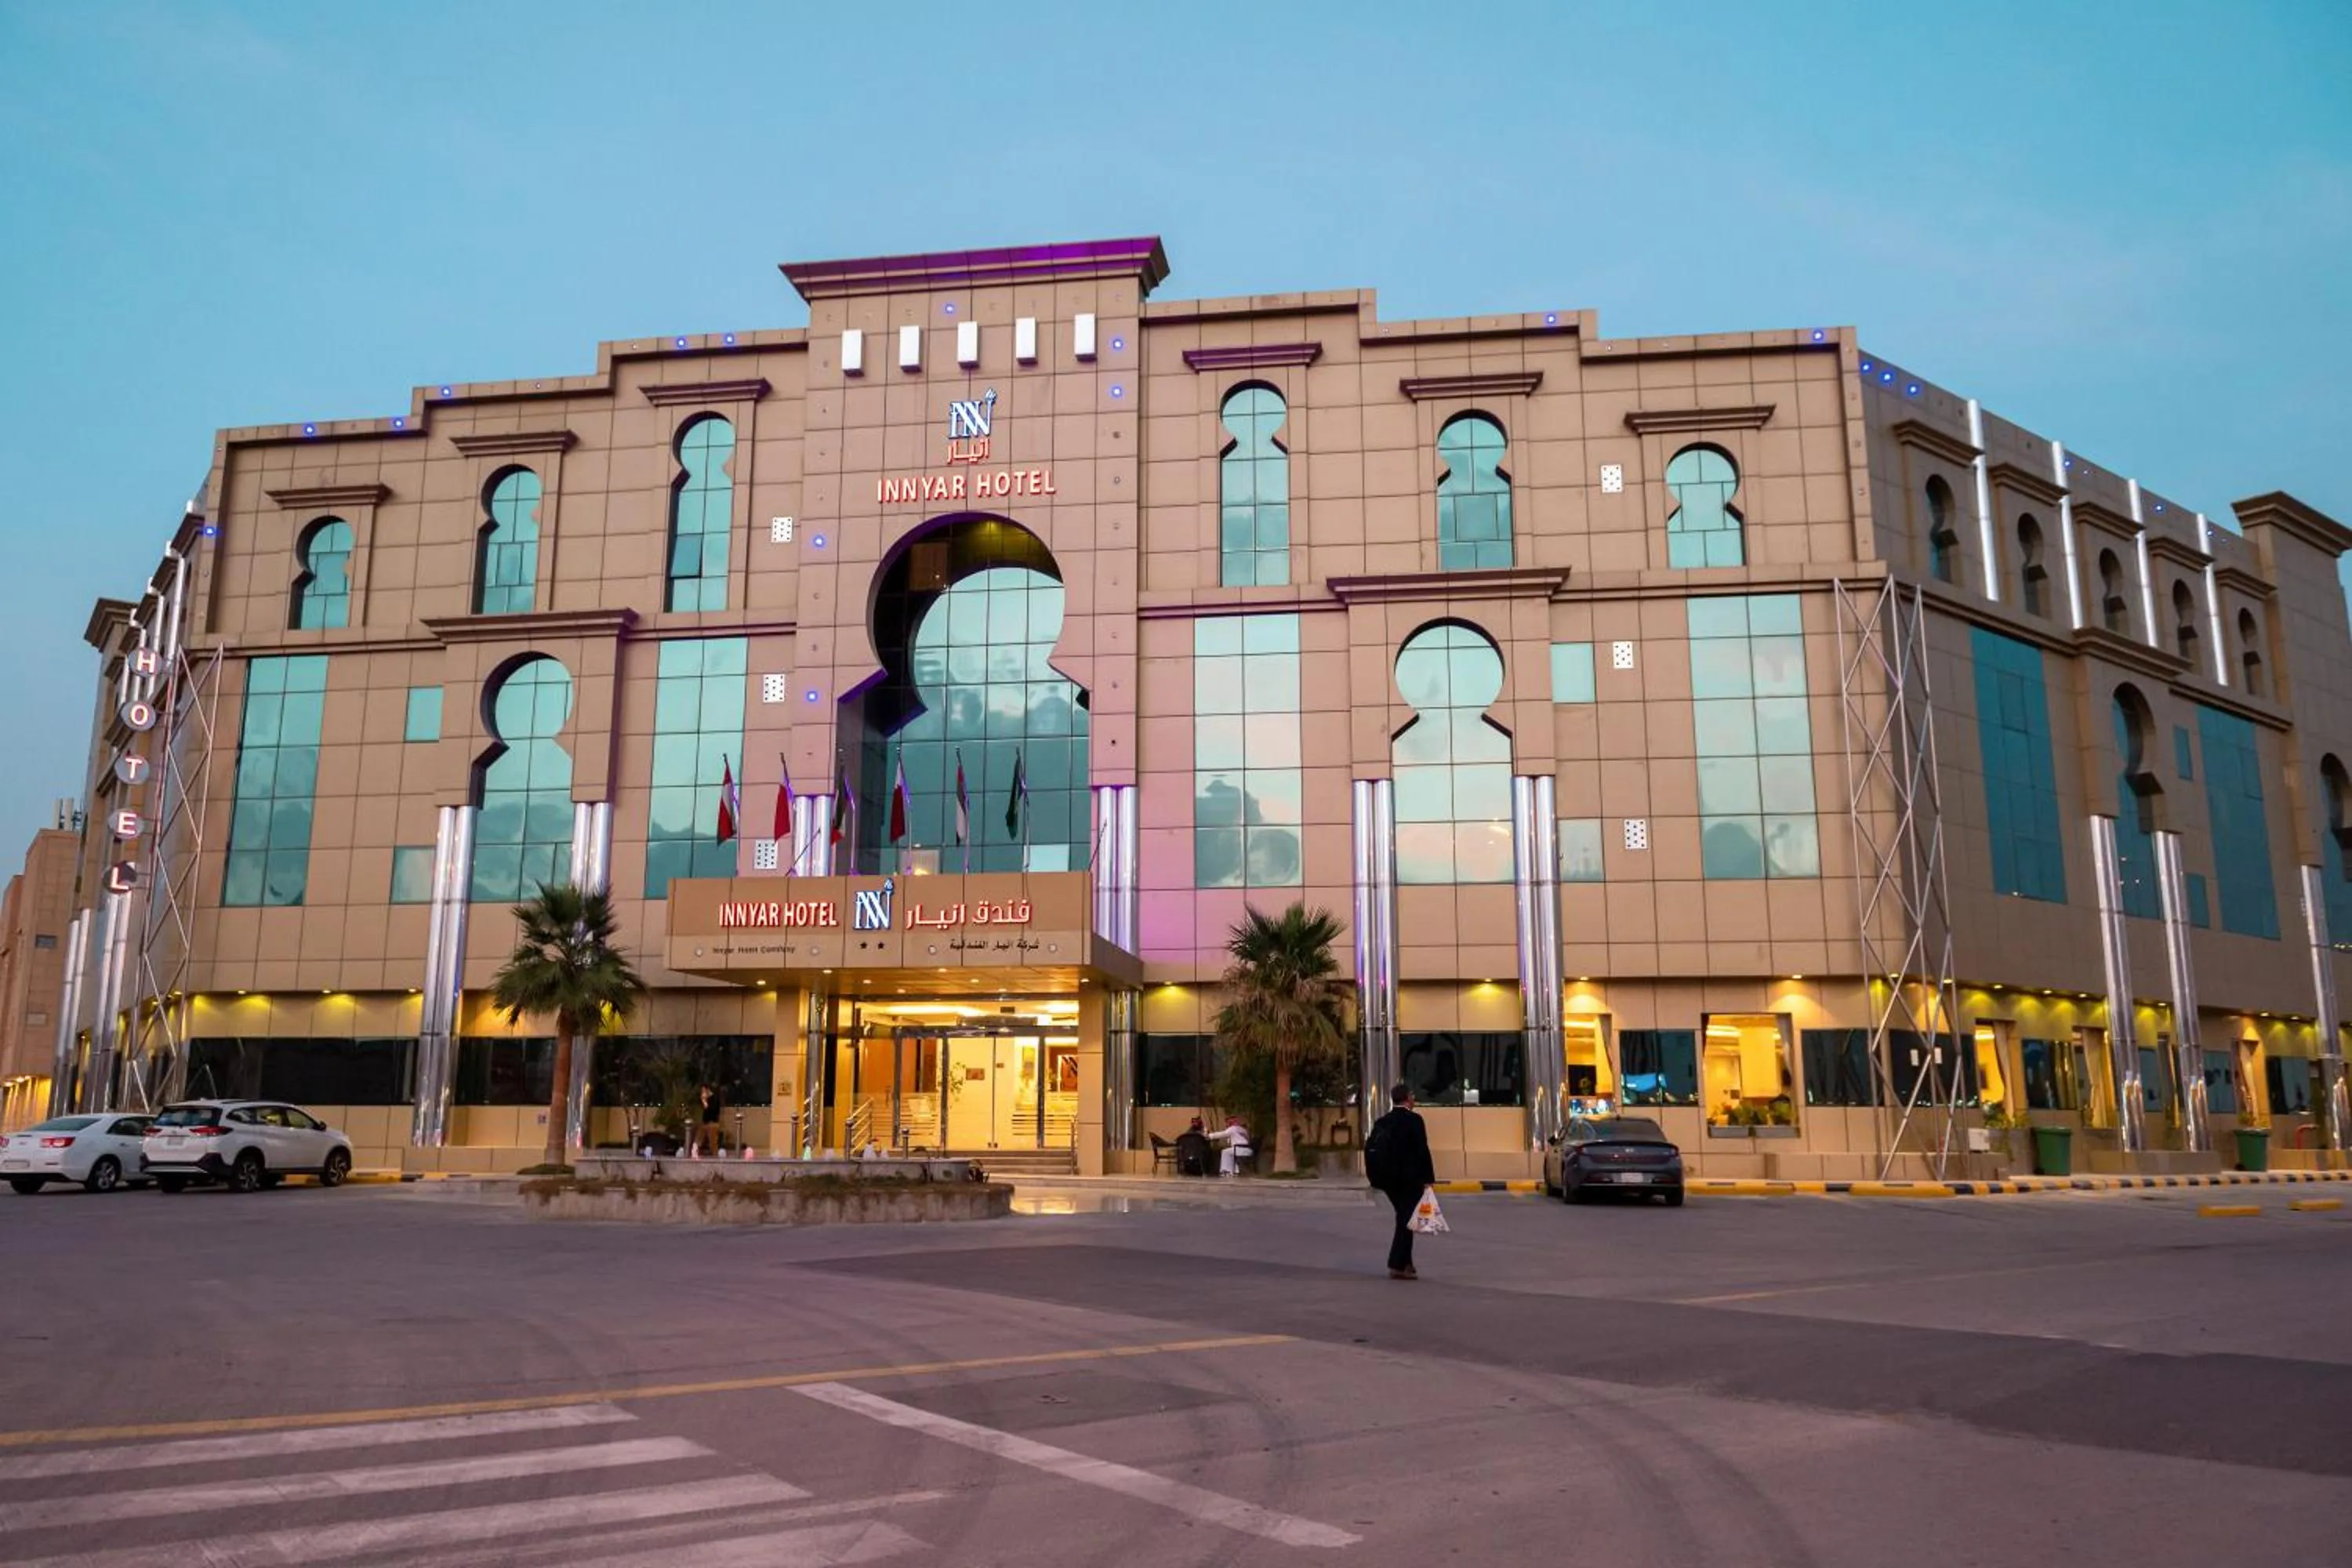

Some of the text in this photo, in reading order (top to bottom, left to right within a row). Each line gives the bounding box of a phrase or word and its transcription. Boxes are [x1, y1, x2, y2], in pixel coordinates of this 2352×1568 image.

[877, 470, 1056, 503] INNYAR HOTEL
[110, 651, 158, 891] HOTEL
[718, 902, 839, 927] INNYAR HOTEL
[905, 898, 1033, 931] فندق انيار
